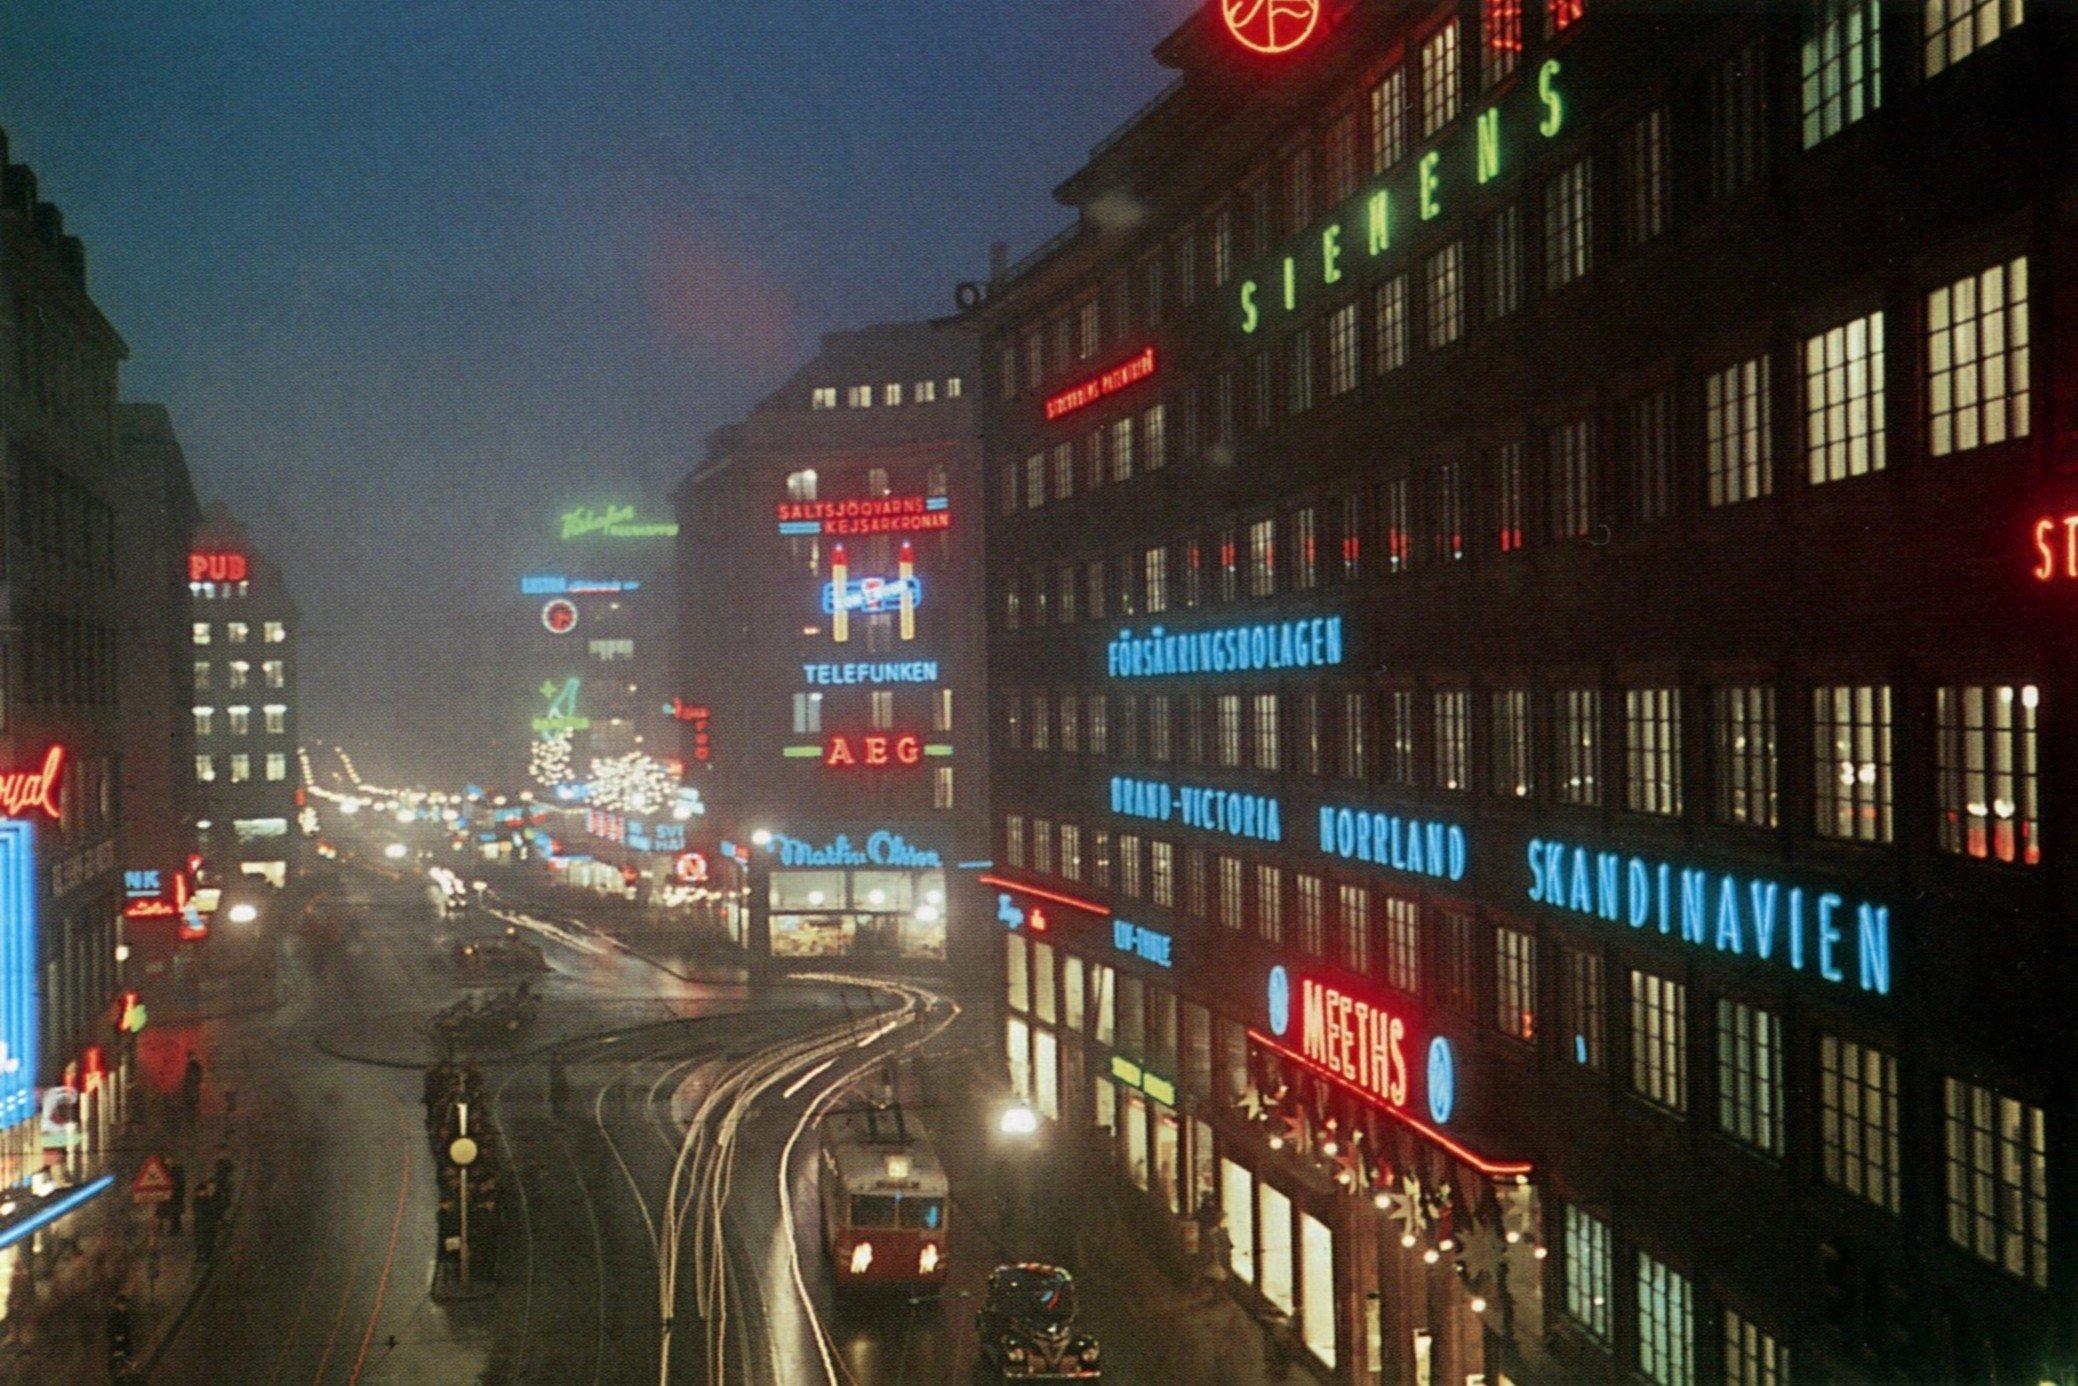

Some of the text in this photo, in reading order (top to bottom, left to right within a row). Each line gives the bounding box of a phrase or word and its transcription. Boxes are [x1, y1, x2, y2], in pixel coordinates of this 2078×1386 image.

[1240, 58, 1563, 334] SIEMENS
[188, 553, 247, 581] PUB
[803, 661, 938, 684] TELEFUNKEN
[1108, 616, 1342, 677] FÖRSÄKRINGSBOLAGEN
[827, 737, 919, 765] AEG
[1111, 776, 1282, 842] BRAND-VICTORIA
[1319, 805, 1466, 881] NORRLAND
[124, 870, 161, 888] NK
[1527, 837, 1891, 996] SKANDINAVIEN
[1302, 978, 1407, 1107] MEETHS
